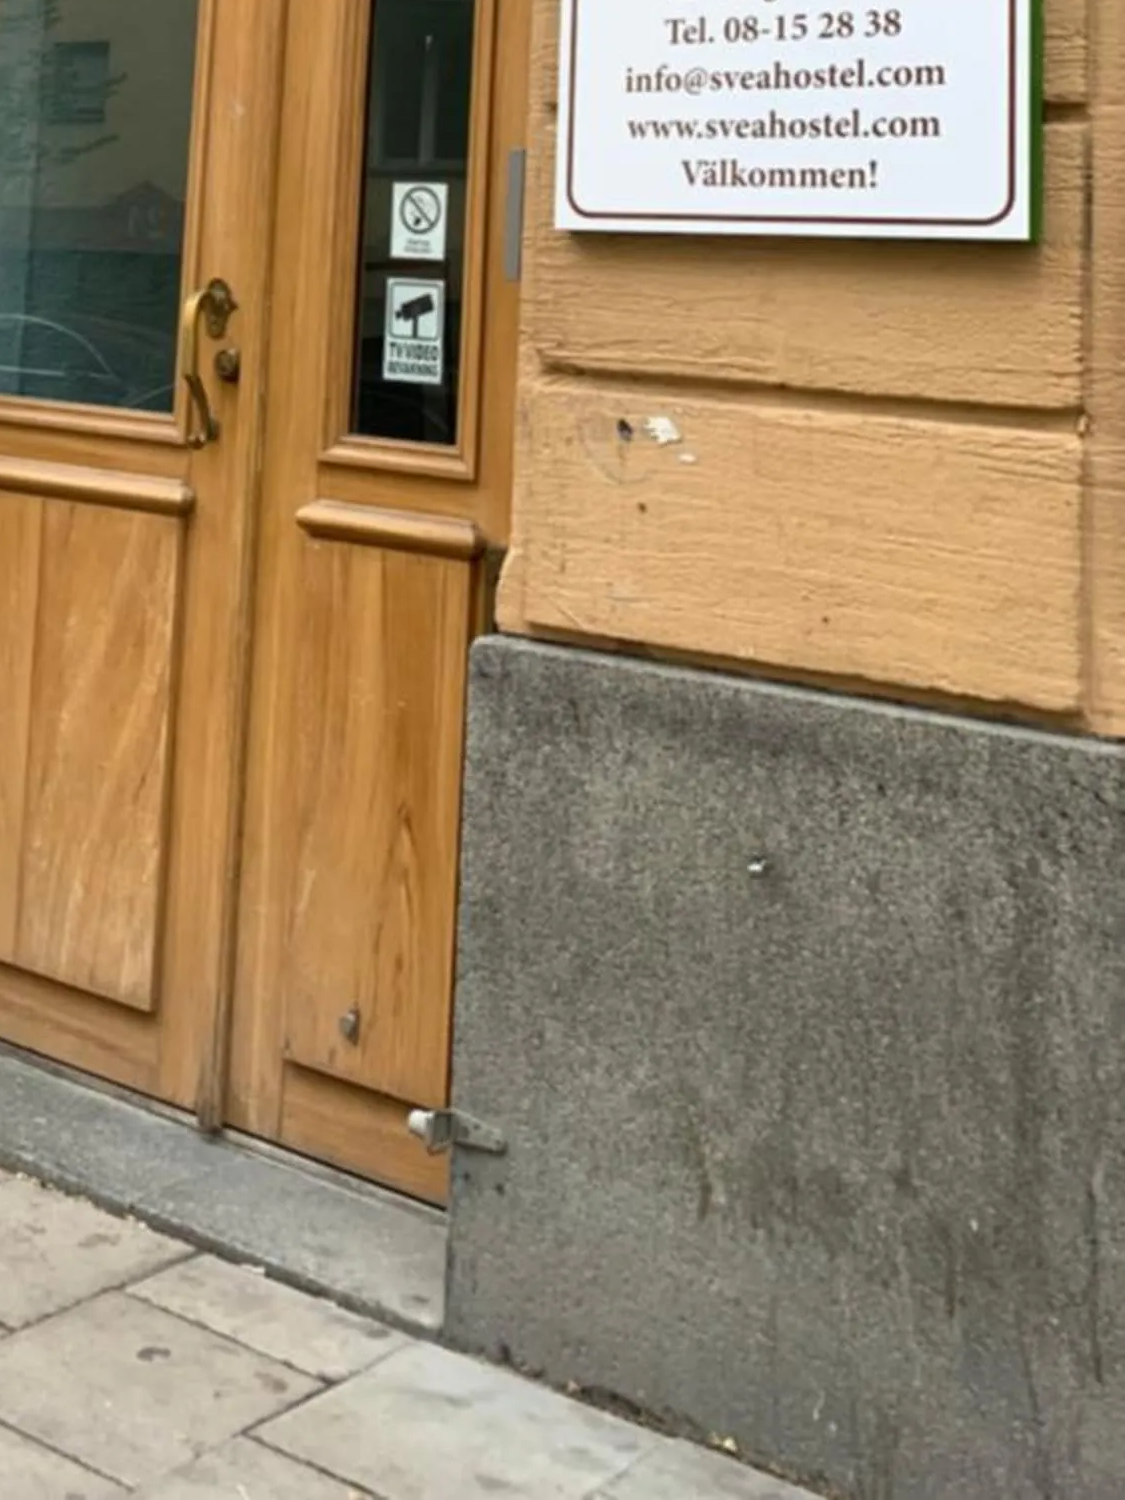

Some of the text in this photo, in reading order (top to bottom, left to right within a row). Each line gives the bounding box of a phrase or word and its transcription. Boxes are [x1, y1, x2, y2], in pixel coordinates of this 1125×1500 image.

[664, 9, 902, 46] Tel. 08-15 28 38
[625, 58, 946, 96] info@sveahostel.com
[627, 108, 942, 140] www.sveahostel.com
[680, 157, 878, 189] Välkommen!
